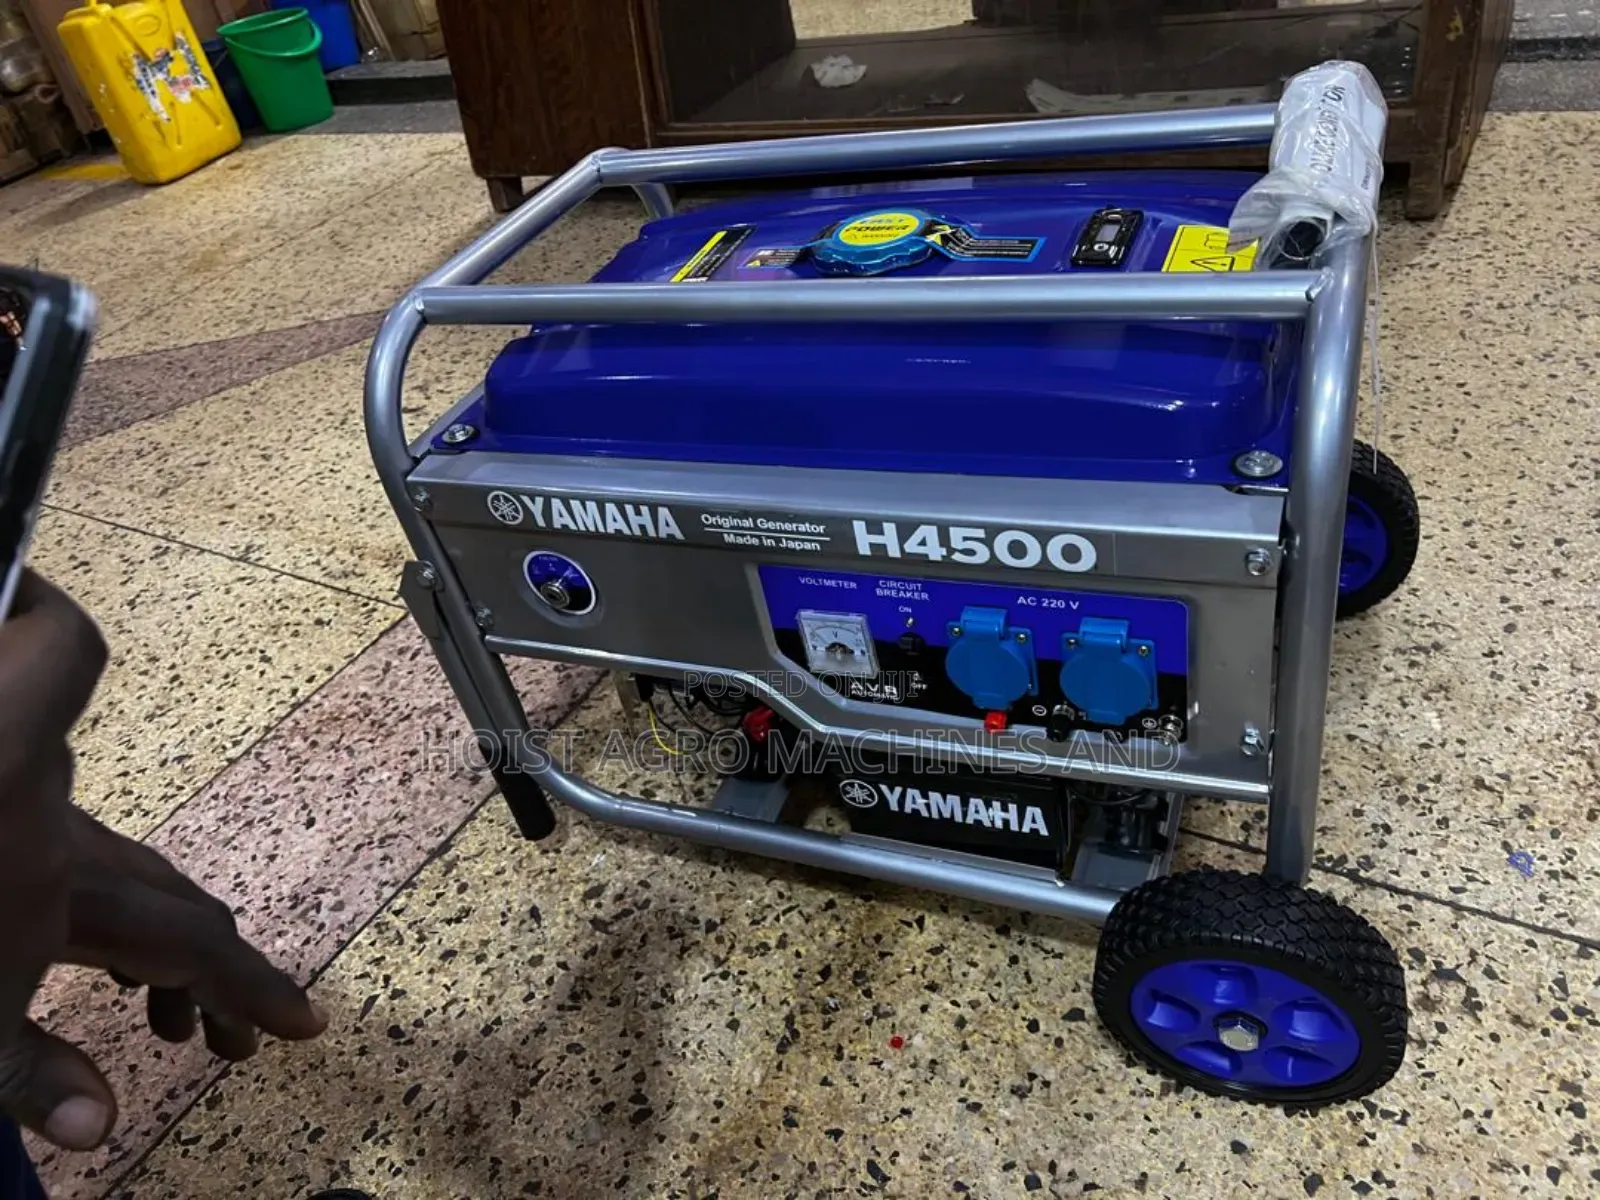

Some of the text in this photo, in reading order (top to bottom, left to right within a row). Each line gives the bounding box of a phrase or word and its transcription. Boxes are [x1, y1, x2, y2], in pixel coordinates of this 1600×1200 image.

[519, 495, 685, 540] YAMAHA
[700, 513, 826, 534] Original Generator
[723, 533, 821, 551] Made in Japan
[852, 520, 1097, 573] H4500
[799, 577, 857, 589] VOLTMETER
[878, 580, 922, 591] CIRCUIT
[875, 588, 929, 600] BREAKER
[898, 605, 912, 613] ON
[1017, 596, 1080, 610] AC 220 V
[878, 784, 1050, 837] YAMAHA
